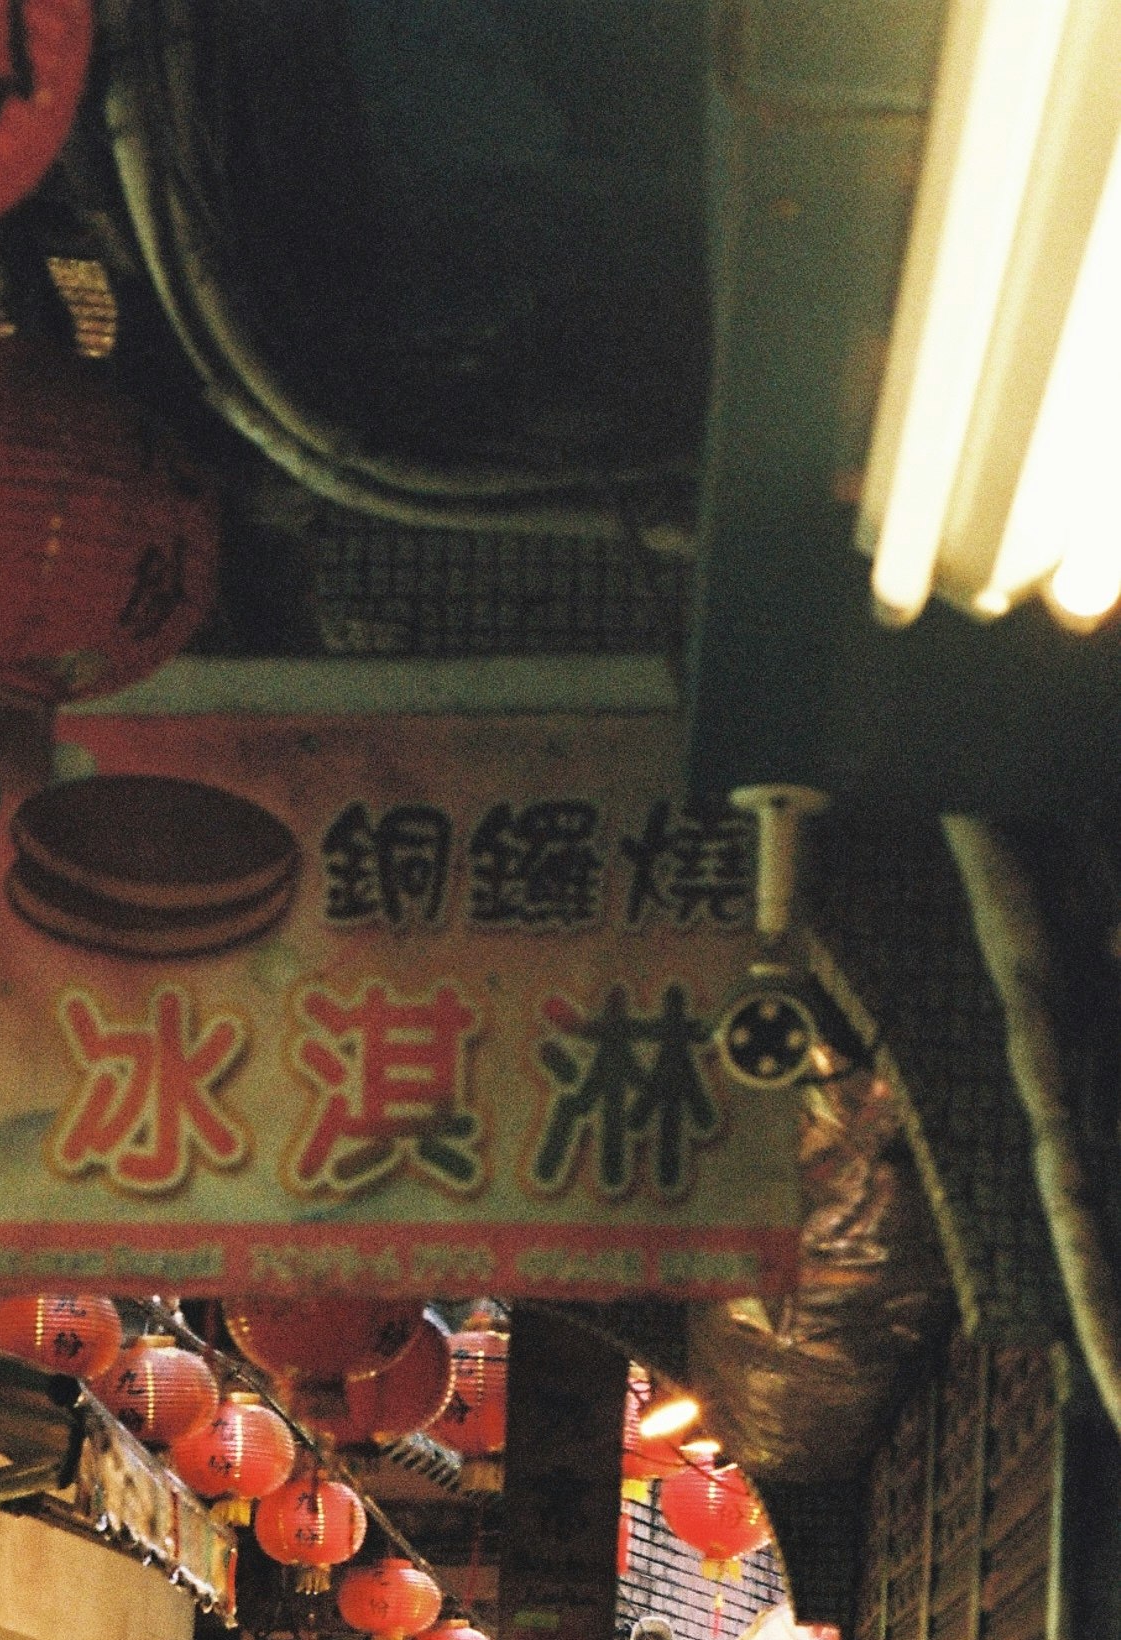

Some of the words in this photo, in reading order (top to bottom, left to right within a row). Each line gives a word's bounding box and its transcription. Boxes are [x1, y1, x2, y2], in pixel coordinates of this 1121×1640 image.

[321, 802, 762, 924] 銅鑼燒
[56, 980, 723, 1190] 冰淇淋
[117, 1370, 148, 1433] 九份
